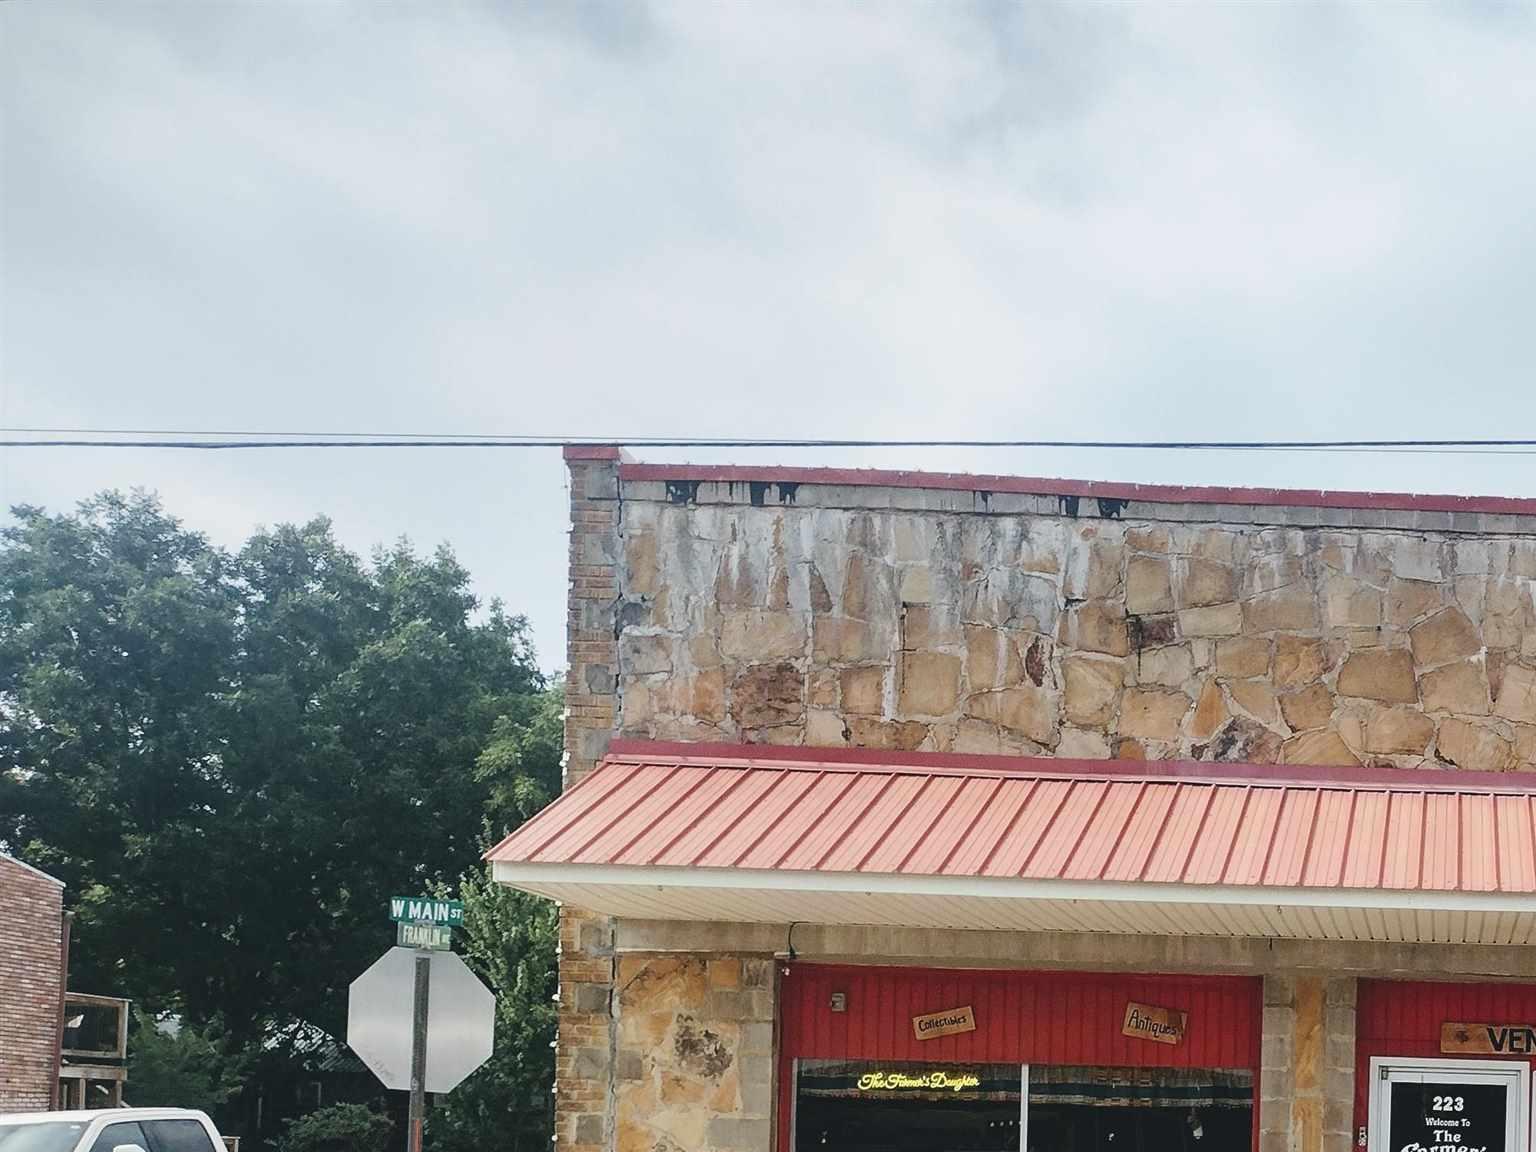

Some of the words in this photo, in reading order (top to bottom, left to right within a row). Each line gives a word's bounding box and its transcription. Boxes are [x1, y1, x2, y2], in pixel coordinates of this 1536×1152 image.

[392, 899, 405, 918] W
[408, 901, 449, 921] MAIN
[450, 909, 463, 919] ST
[402, 925, 441, 946] FRANKLIN
[918, 1015, 967, 1032] Collectibles
[1127, 1008, 1177, 1039] Antiques
[857, 1072, 885, 1090] The
[885, 1073, 930, 1090] Farmer's
[930, 1071, 981, 1092] Daughter
[1432, 1095, 1465, 1112] 223
[1425, 1117, 1459, 1127] Welcome
[1461, 1118, 1471, 1127] To
[1433, 1129, 1462, 1143] The
